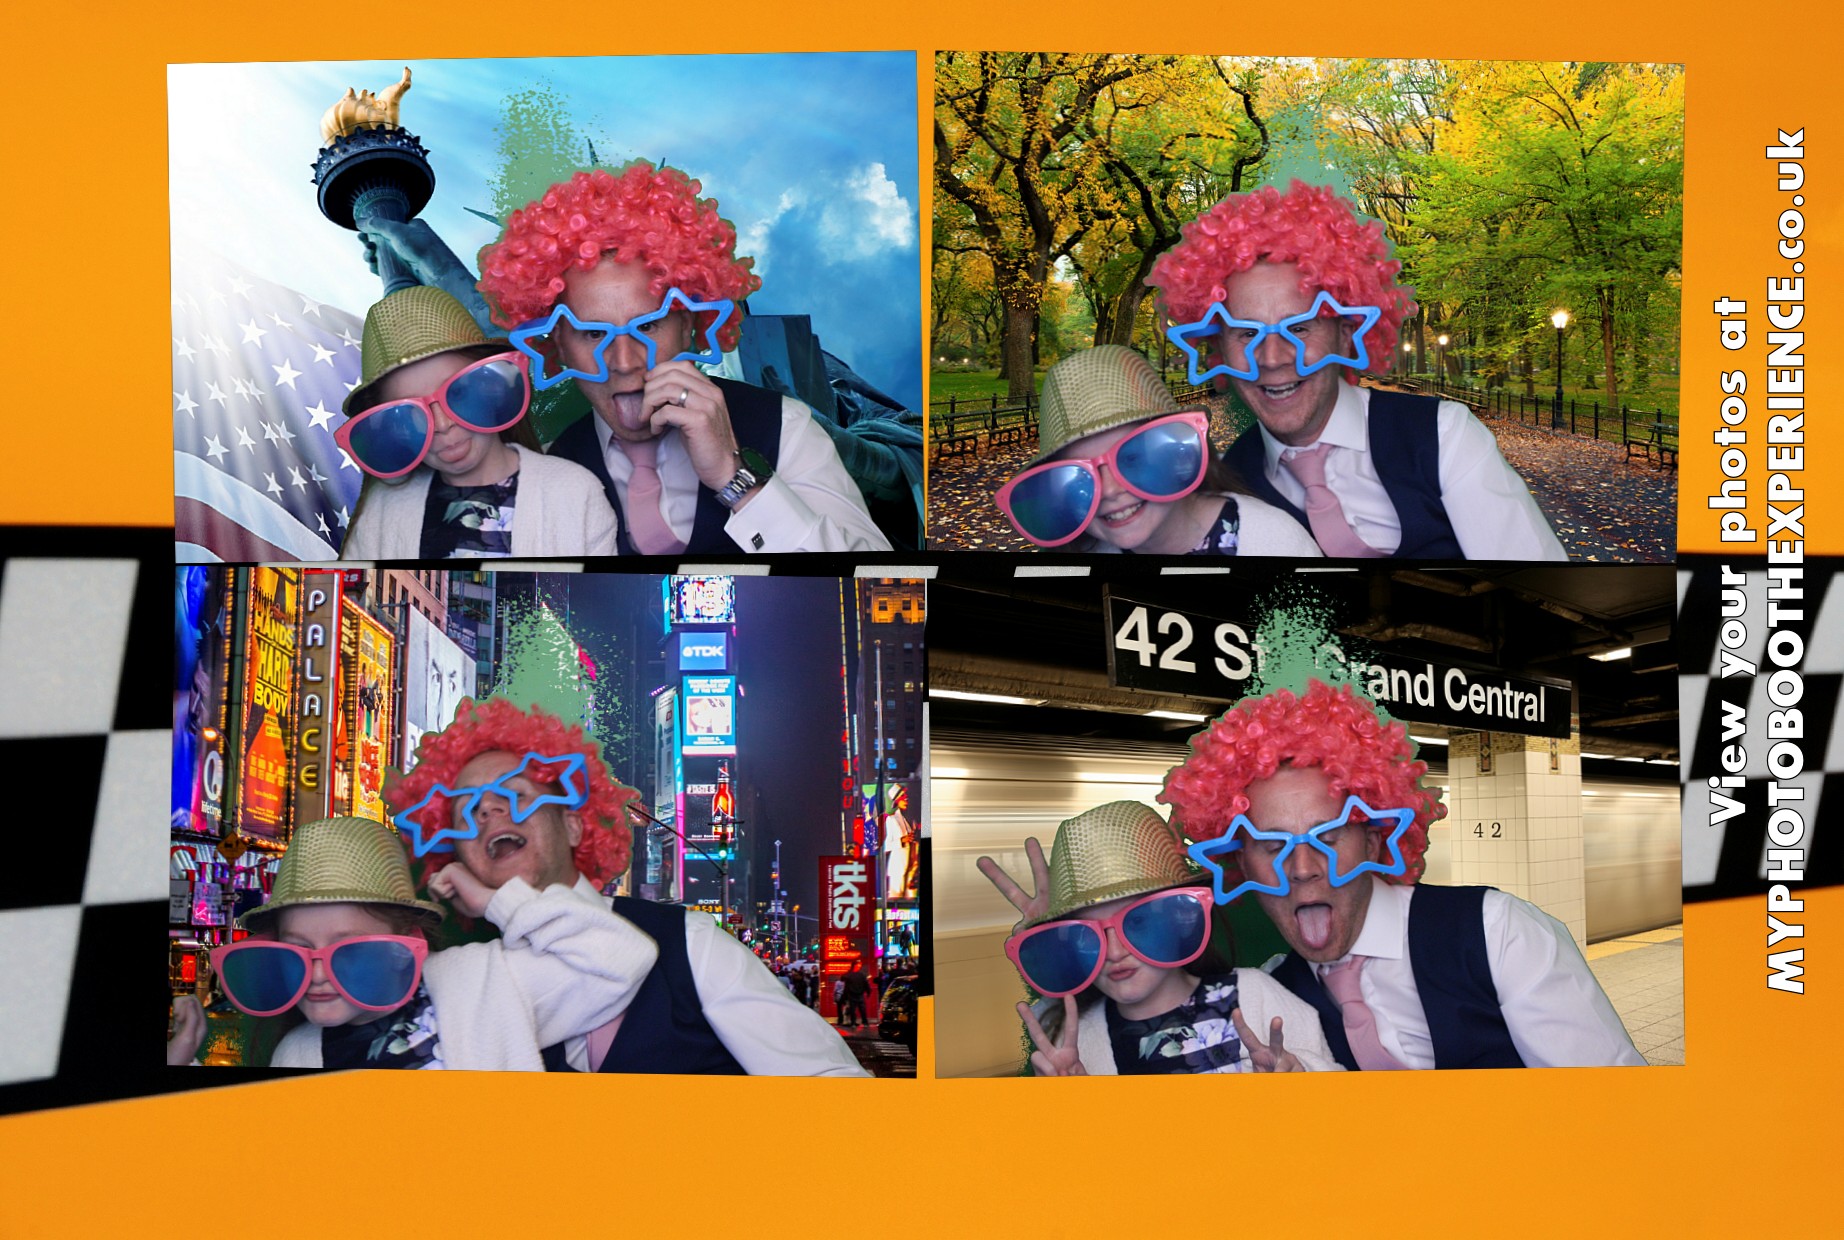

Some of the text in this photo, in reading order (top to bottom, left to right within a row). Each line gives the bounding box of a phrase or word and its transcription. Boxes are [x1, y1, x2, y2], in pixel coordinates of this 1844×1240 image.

[254, 609, 295, 652] HANDS
[692, 645, 724, 657] TDK
[258, 639, 290, 692] HARD
[300, 589, 327, 788] PALACE
[1115, 606, 1197, 673] 42
[1444, 667, 1546, 723] Central
[254, 682, 289, 717] BODY
[833, 861, 868, 929] tkts
